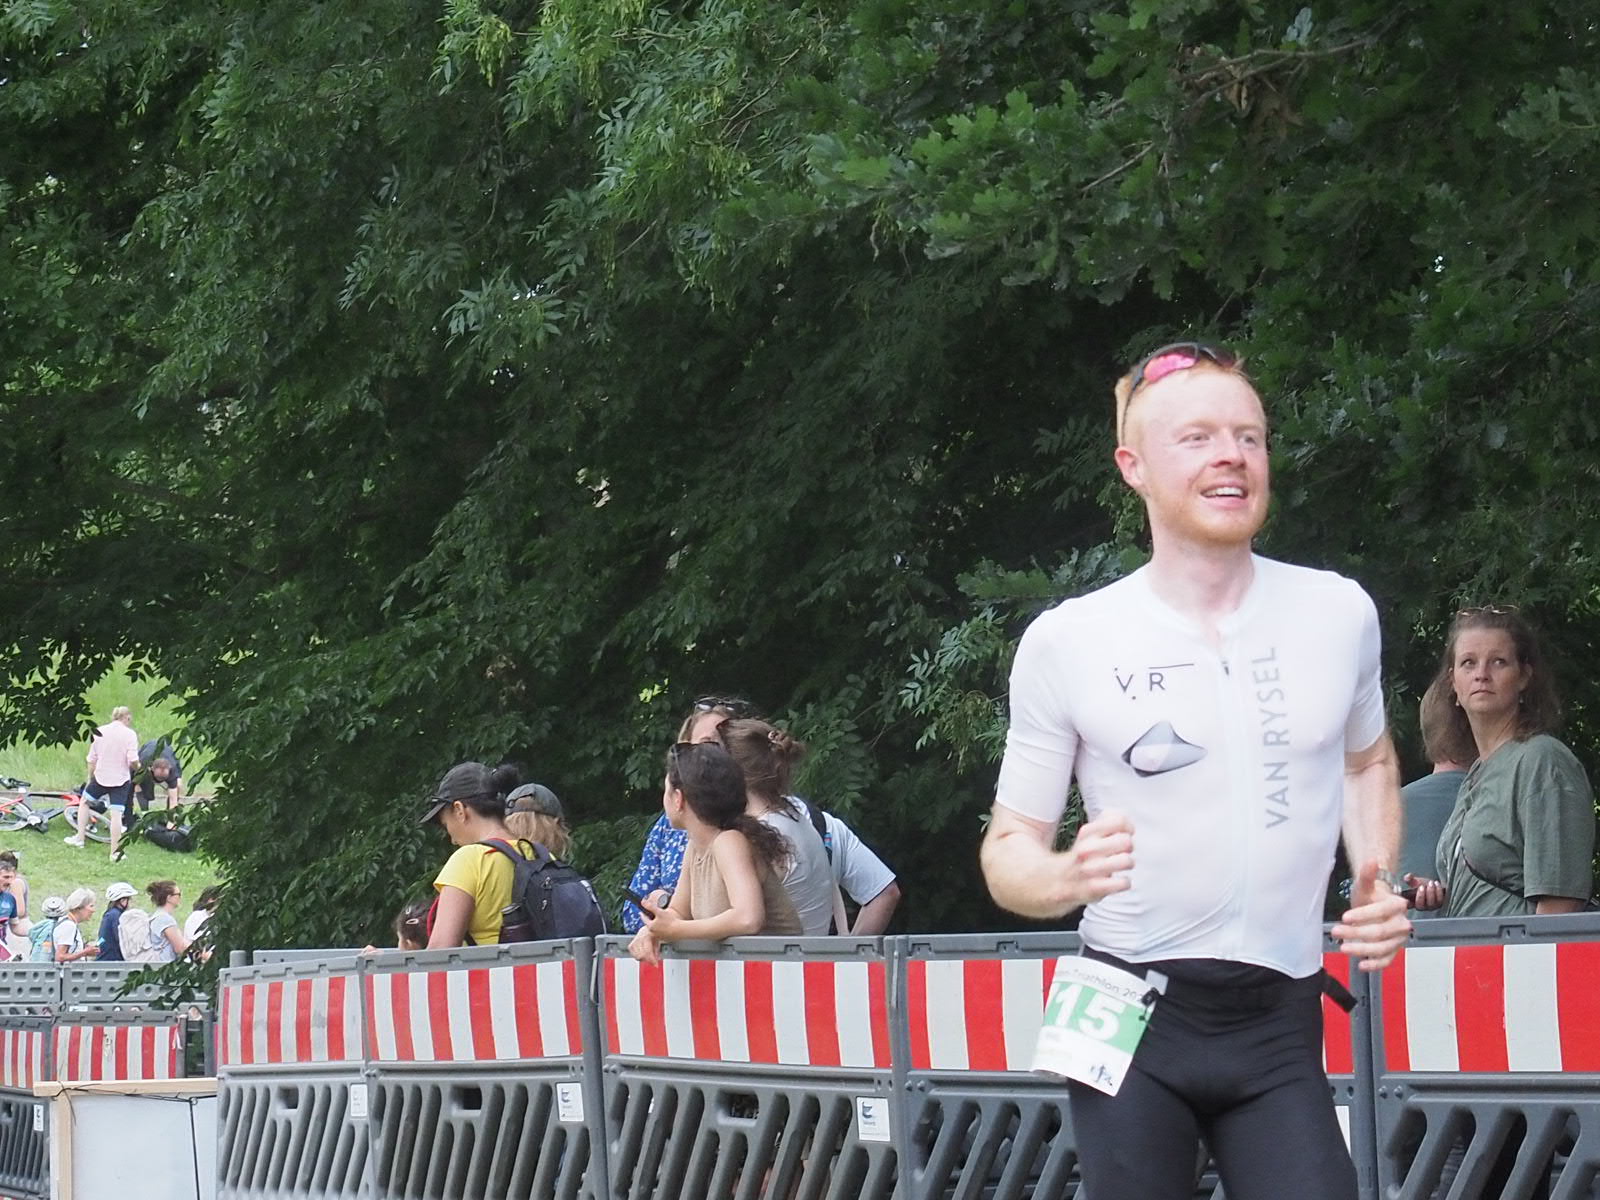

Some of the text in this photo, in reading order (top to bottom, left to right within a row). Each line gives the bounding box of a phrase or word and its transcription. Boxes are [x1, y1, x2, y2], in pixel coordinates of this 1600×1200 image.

[1251, 647, 1290, 829] VAN RYSEL
[1049, 981, 1120, 1041] 15
